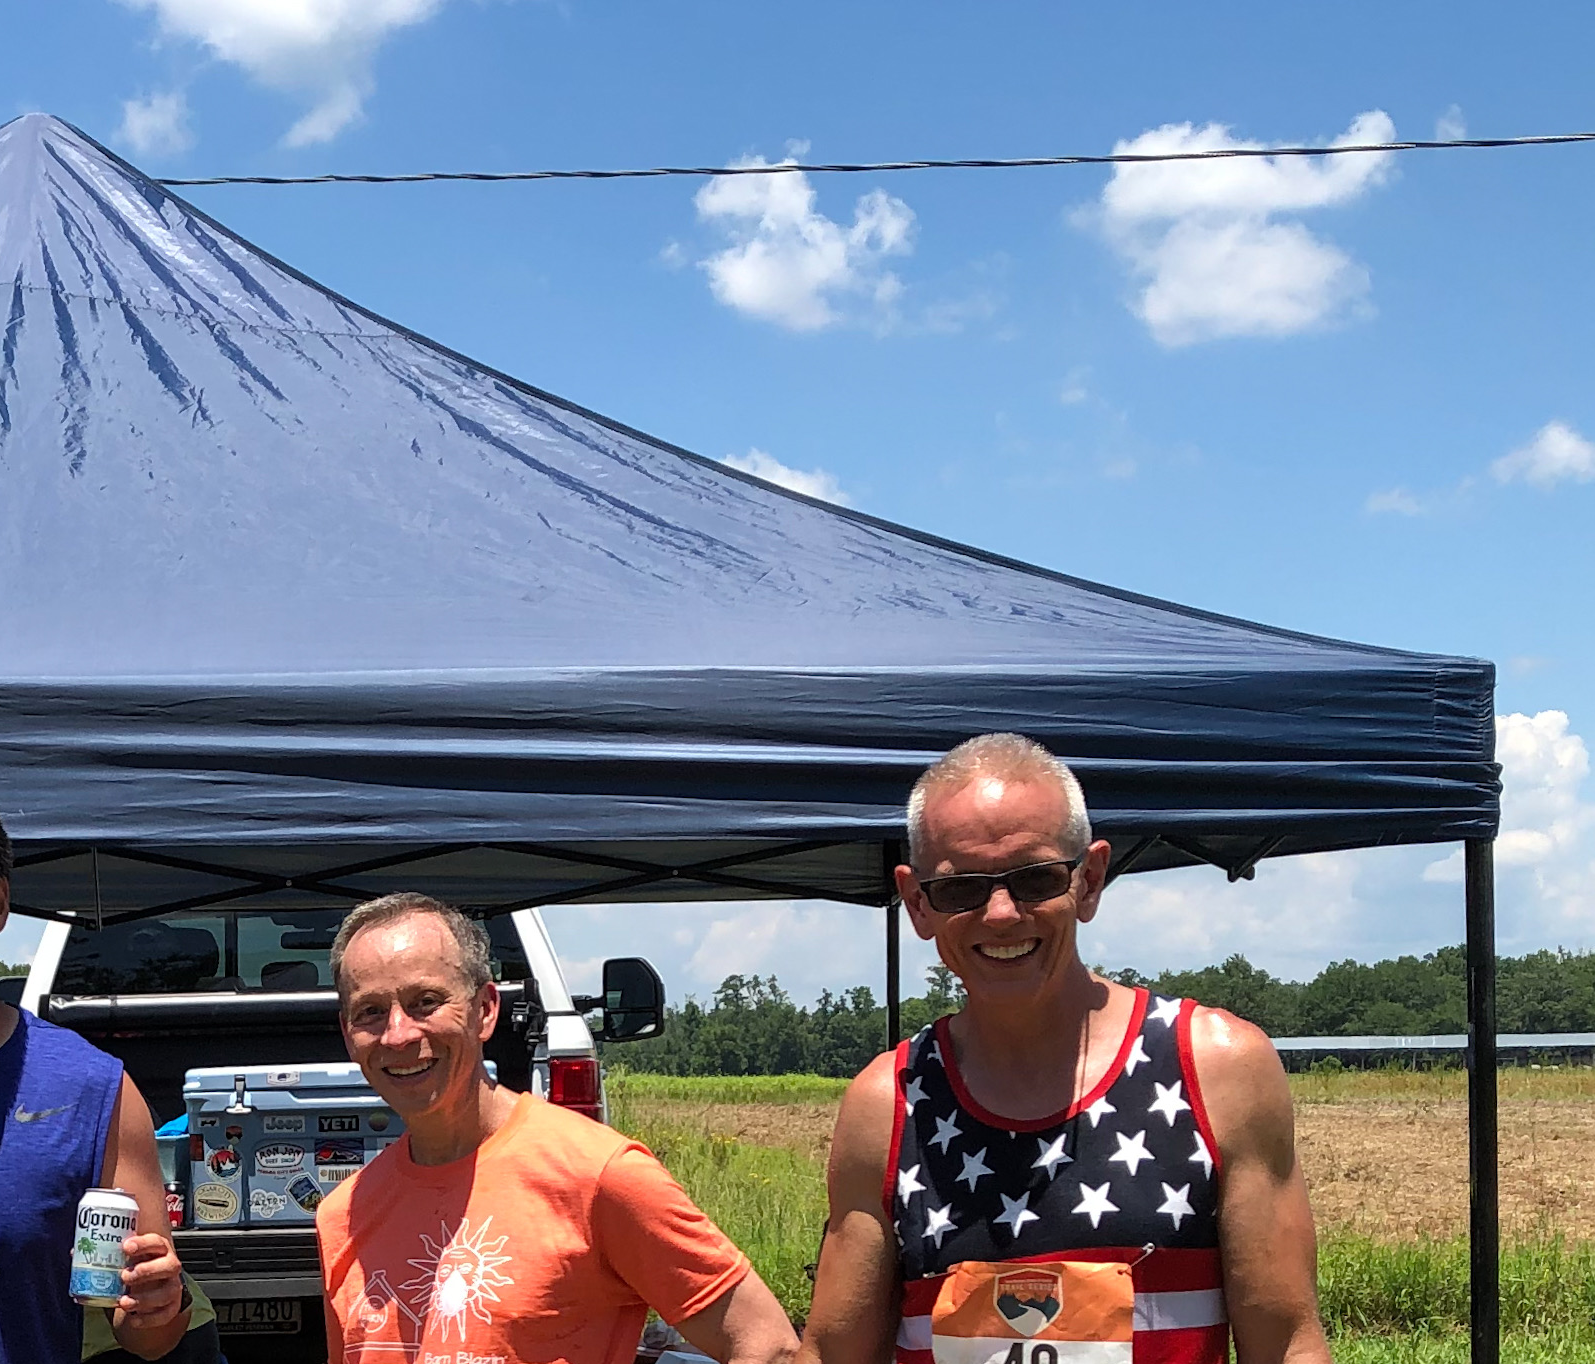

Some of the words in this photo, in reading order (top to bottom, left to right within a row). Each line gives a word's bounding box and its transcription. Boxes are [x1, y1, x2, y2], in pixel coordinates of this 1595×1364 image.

[265, 1117, 303, 1131] Jeep
[320, 1118, 356, 1130] YETI
[259, 1146, 280, 1160] RON
[283, 1146, 302, 1156] JON
[79, 1206, 136, 1231] Corona
[197, 1206, 231, 1219] BREWING
[91, 1229, 122, 1243] Extra
